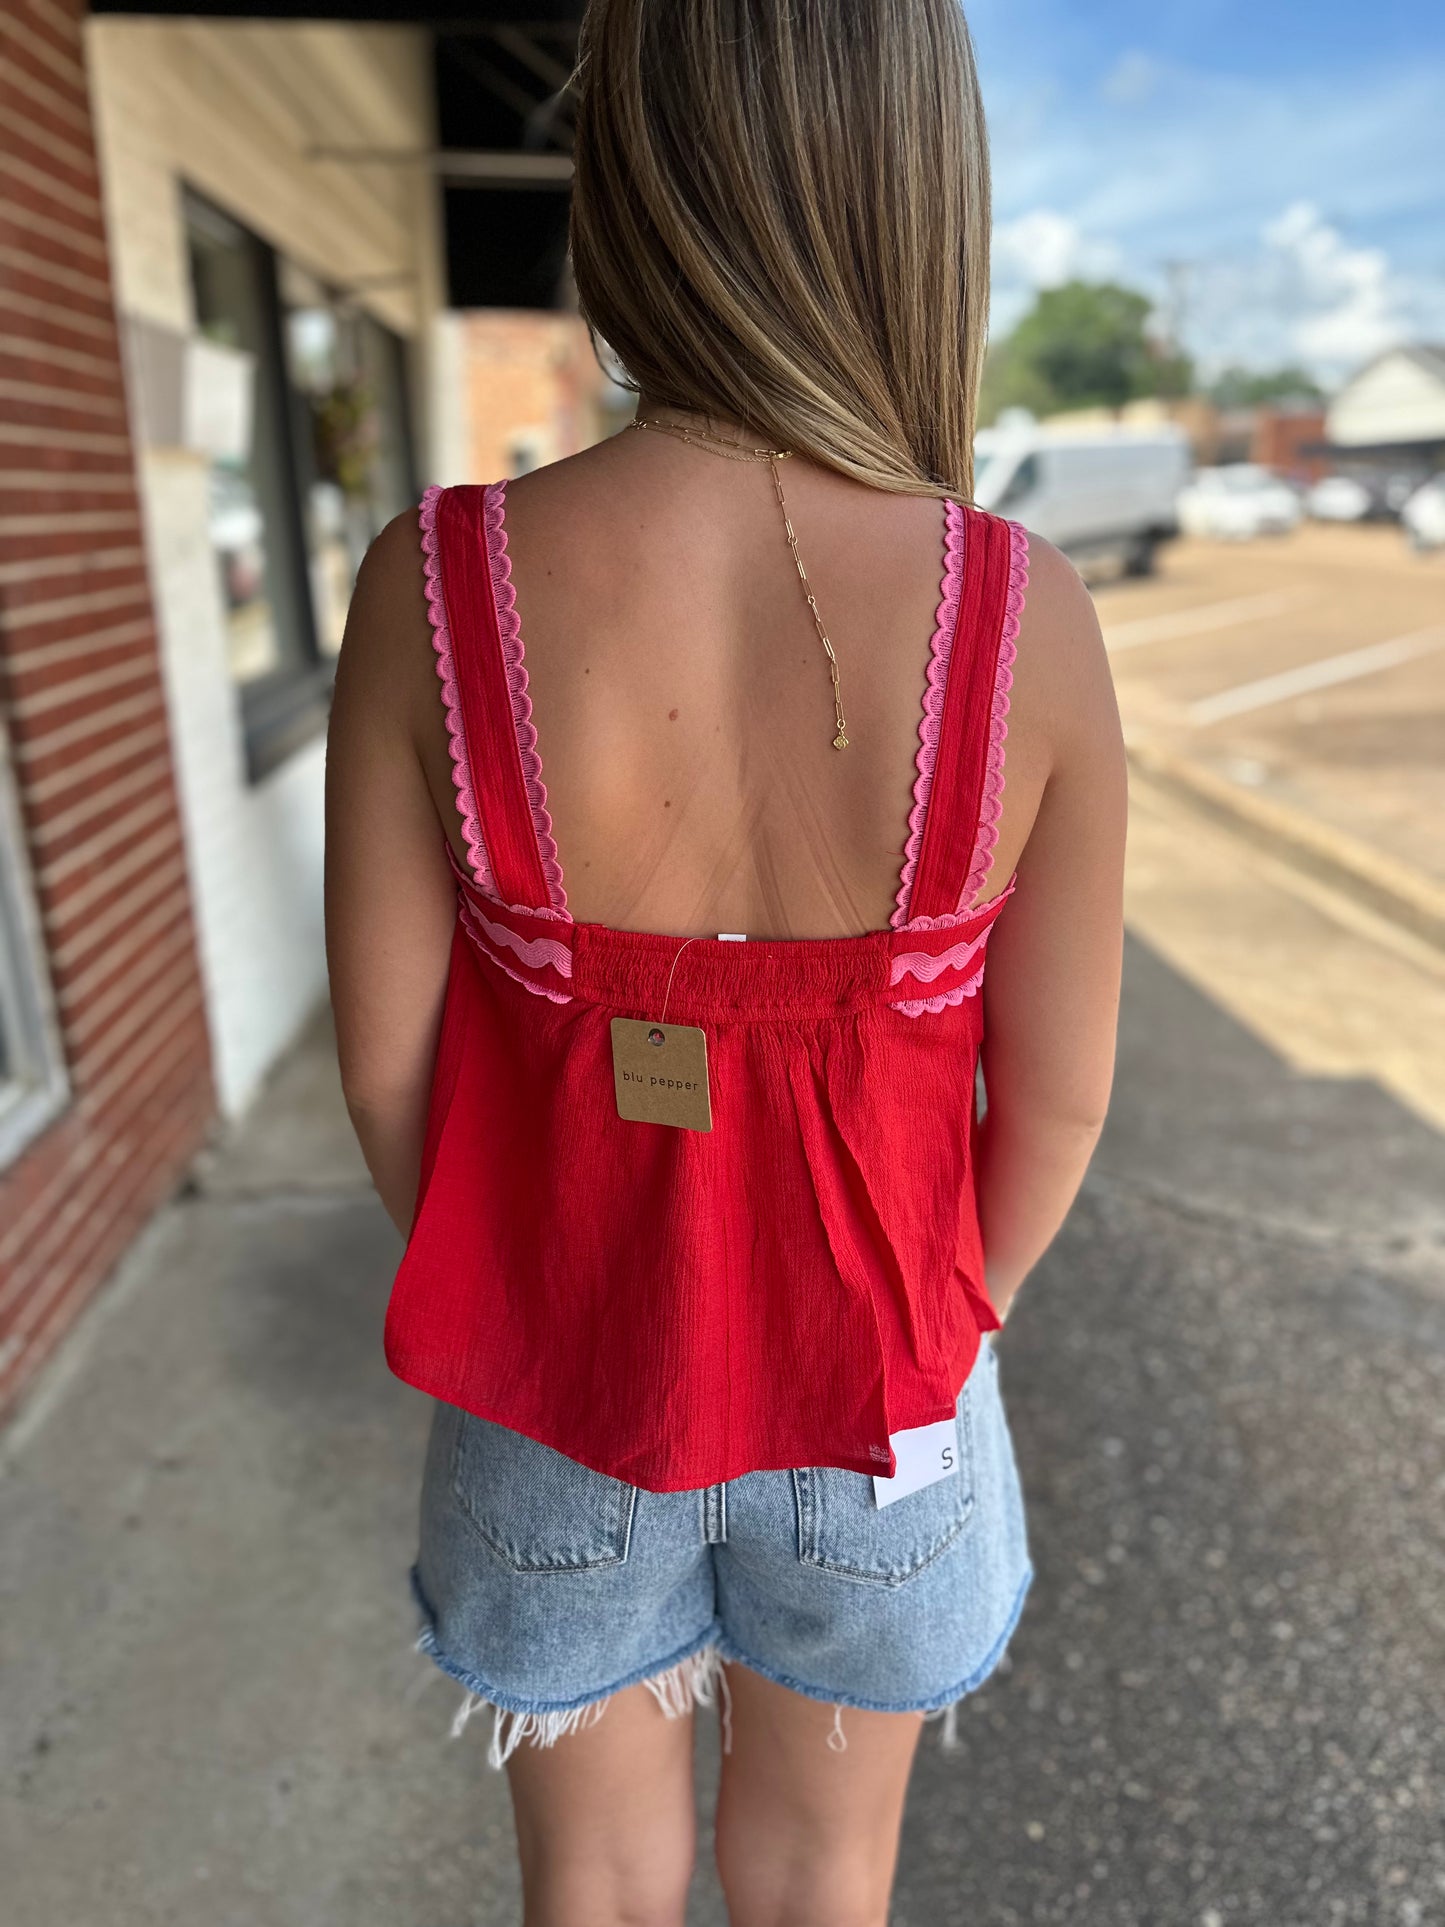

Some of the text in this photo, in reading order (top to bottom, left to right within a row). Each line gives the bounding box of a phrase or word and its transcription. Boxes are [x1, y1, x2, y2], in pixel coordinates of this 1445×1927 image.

[623, 1071, 698, 1091] blu pepper
[941, 1447, 953, 1470] S
